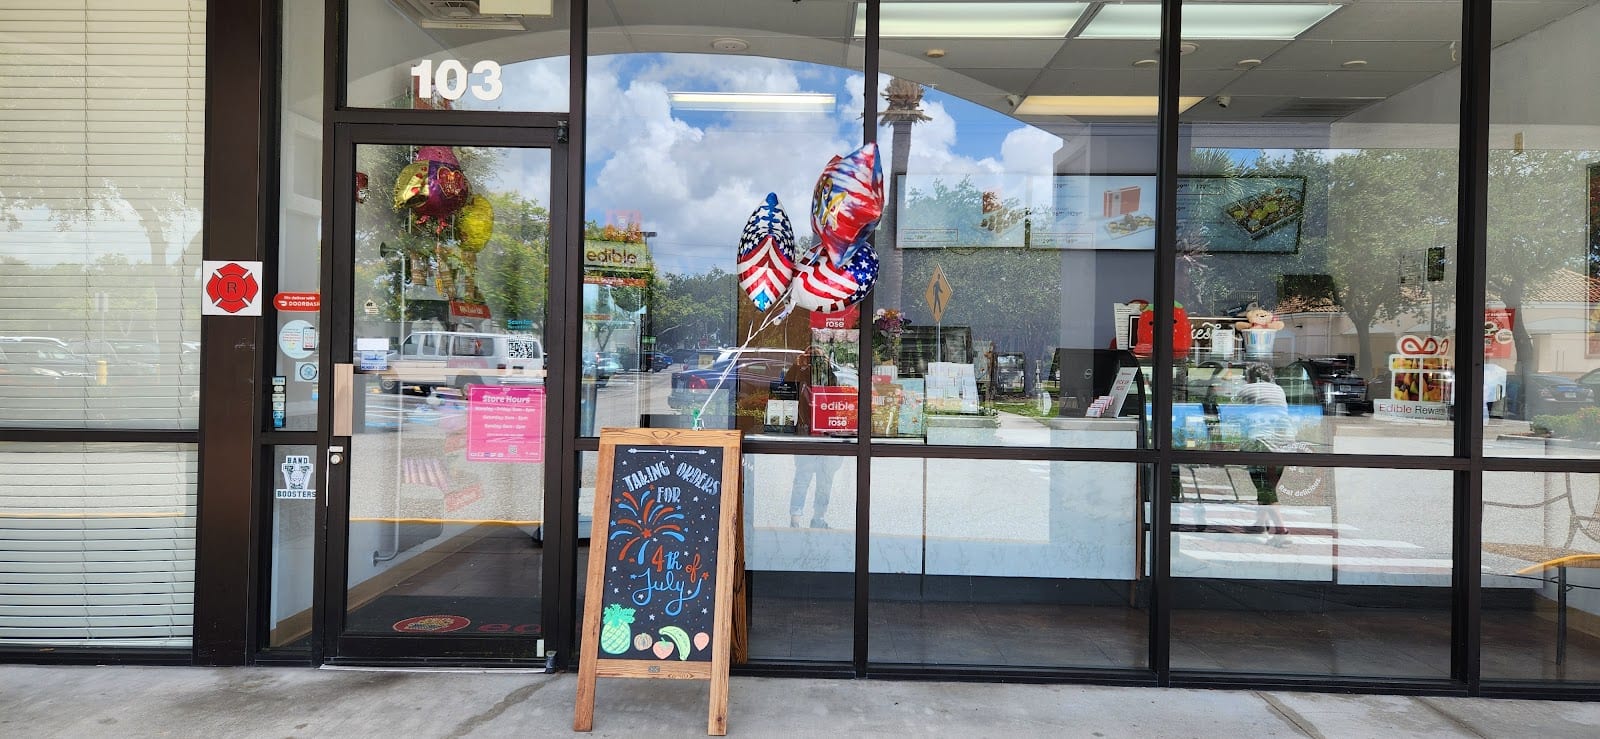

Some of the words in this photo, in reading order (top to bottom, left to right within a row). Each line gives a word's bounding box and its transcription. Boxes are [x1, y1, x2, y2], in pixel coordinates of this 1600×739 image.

[411, 59, 503, 101] 103
[586, 248, 637, 264] edible
[226, 282, 238, 294] R
[826, 320, 845, 328] rose
[482, 395, 505, 403] Store
[506, 396, 531, 404] Hours
[820, 401, 856, 411] edible
[1379, 403, 1413, 414] Edible
[828, 419, 848, 427] rose
[622, 460, 671, 492] TAKING
[675, 461, 721, 496] ORDERS
[277, 490, 317, 498] BOOSTERS
[656, 486, 681, 503] FOR
[651, 545, 682, 573] 4th
[685, 553, 702, 583] of
[632, 567, 702, 616] July
